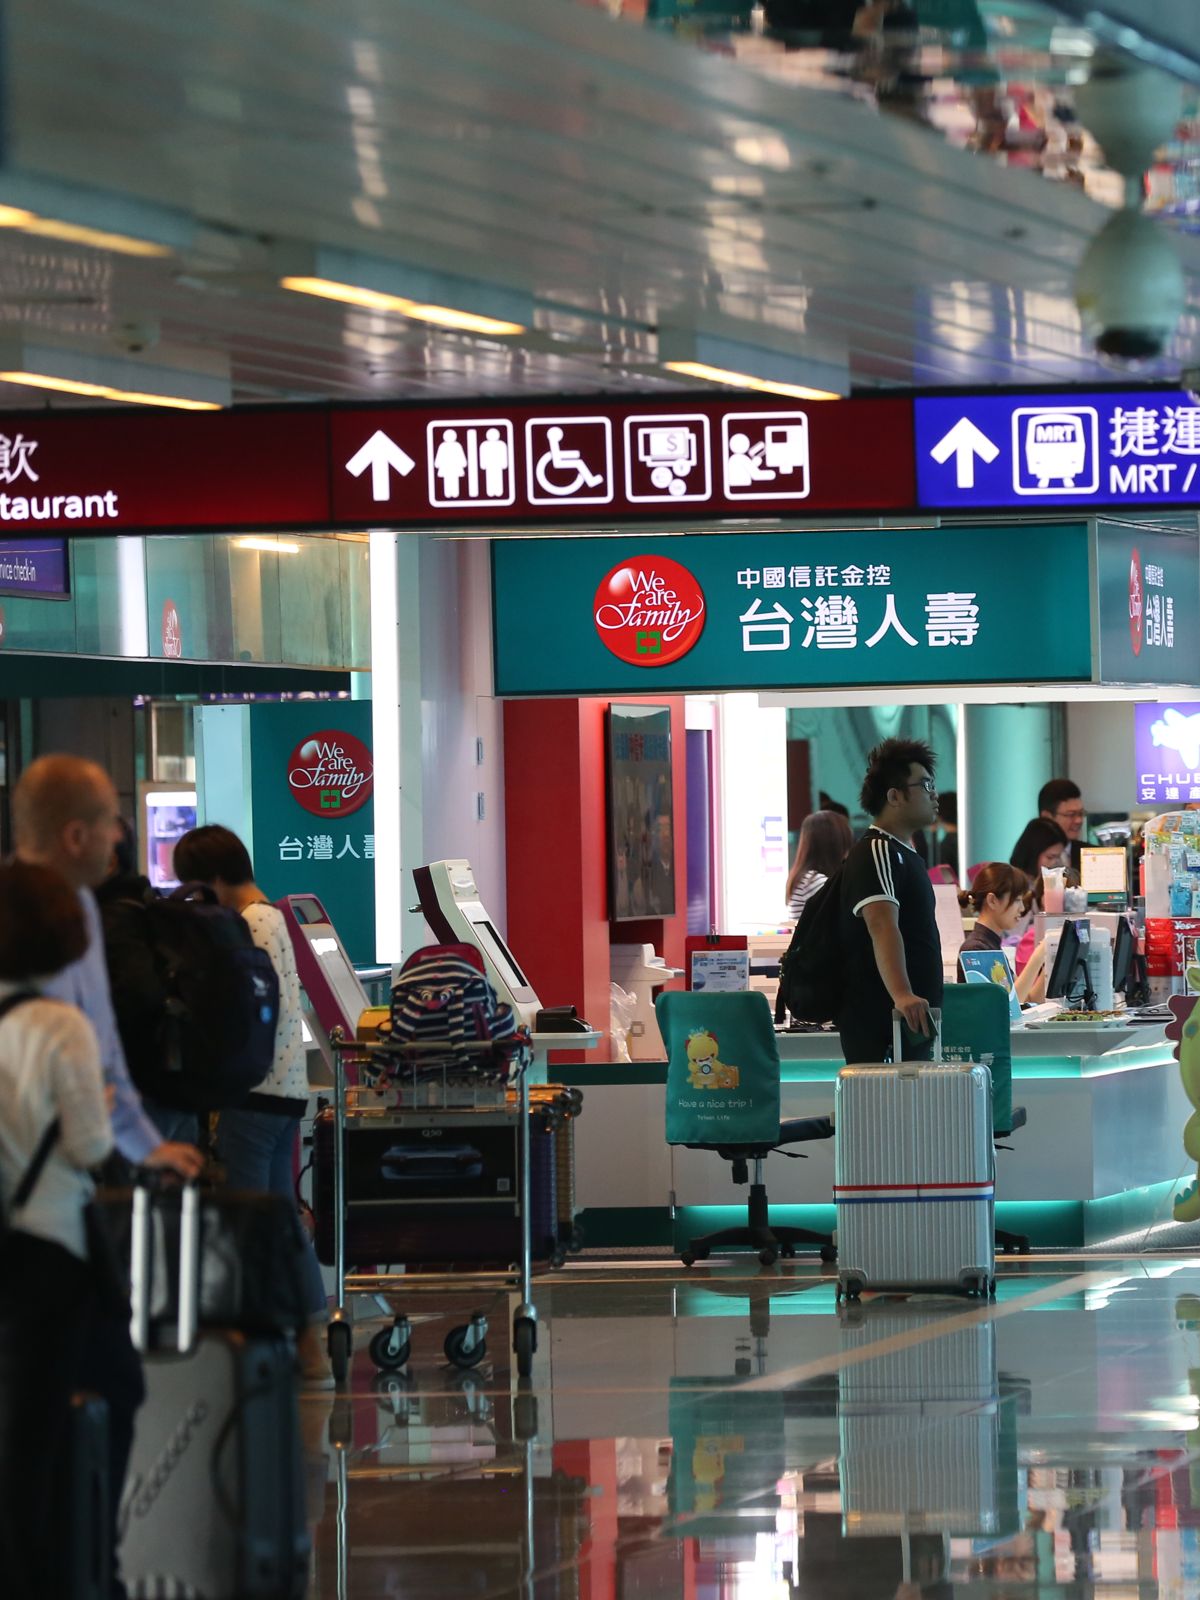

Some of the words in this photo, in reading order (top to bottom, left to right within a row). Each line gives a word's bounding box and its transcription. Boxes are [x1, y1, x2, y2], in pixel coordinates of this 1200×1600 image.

[1035, 424, 1076, 442] MRT
[1109, 464, 1178, 494] MRT
[0, 490, 119, 521] taurant
[627, 570, 666, 592] We
[736, 563, 891, 590] 中國信託金控
[645, 588, 677, 606] are
[596, 590, 704, 642] Family
[738, 591, 980, 652] 台灣人壽
[315, 742, 345, 760] We
[328, 757, 354, 771] are
[289, 757, 375, 798] Family
[678, 1099, 697, 1108] Have
[706, 1099, 726, 1108] nice
[727, 1099, 747, 1109] trip
